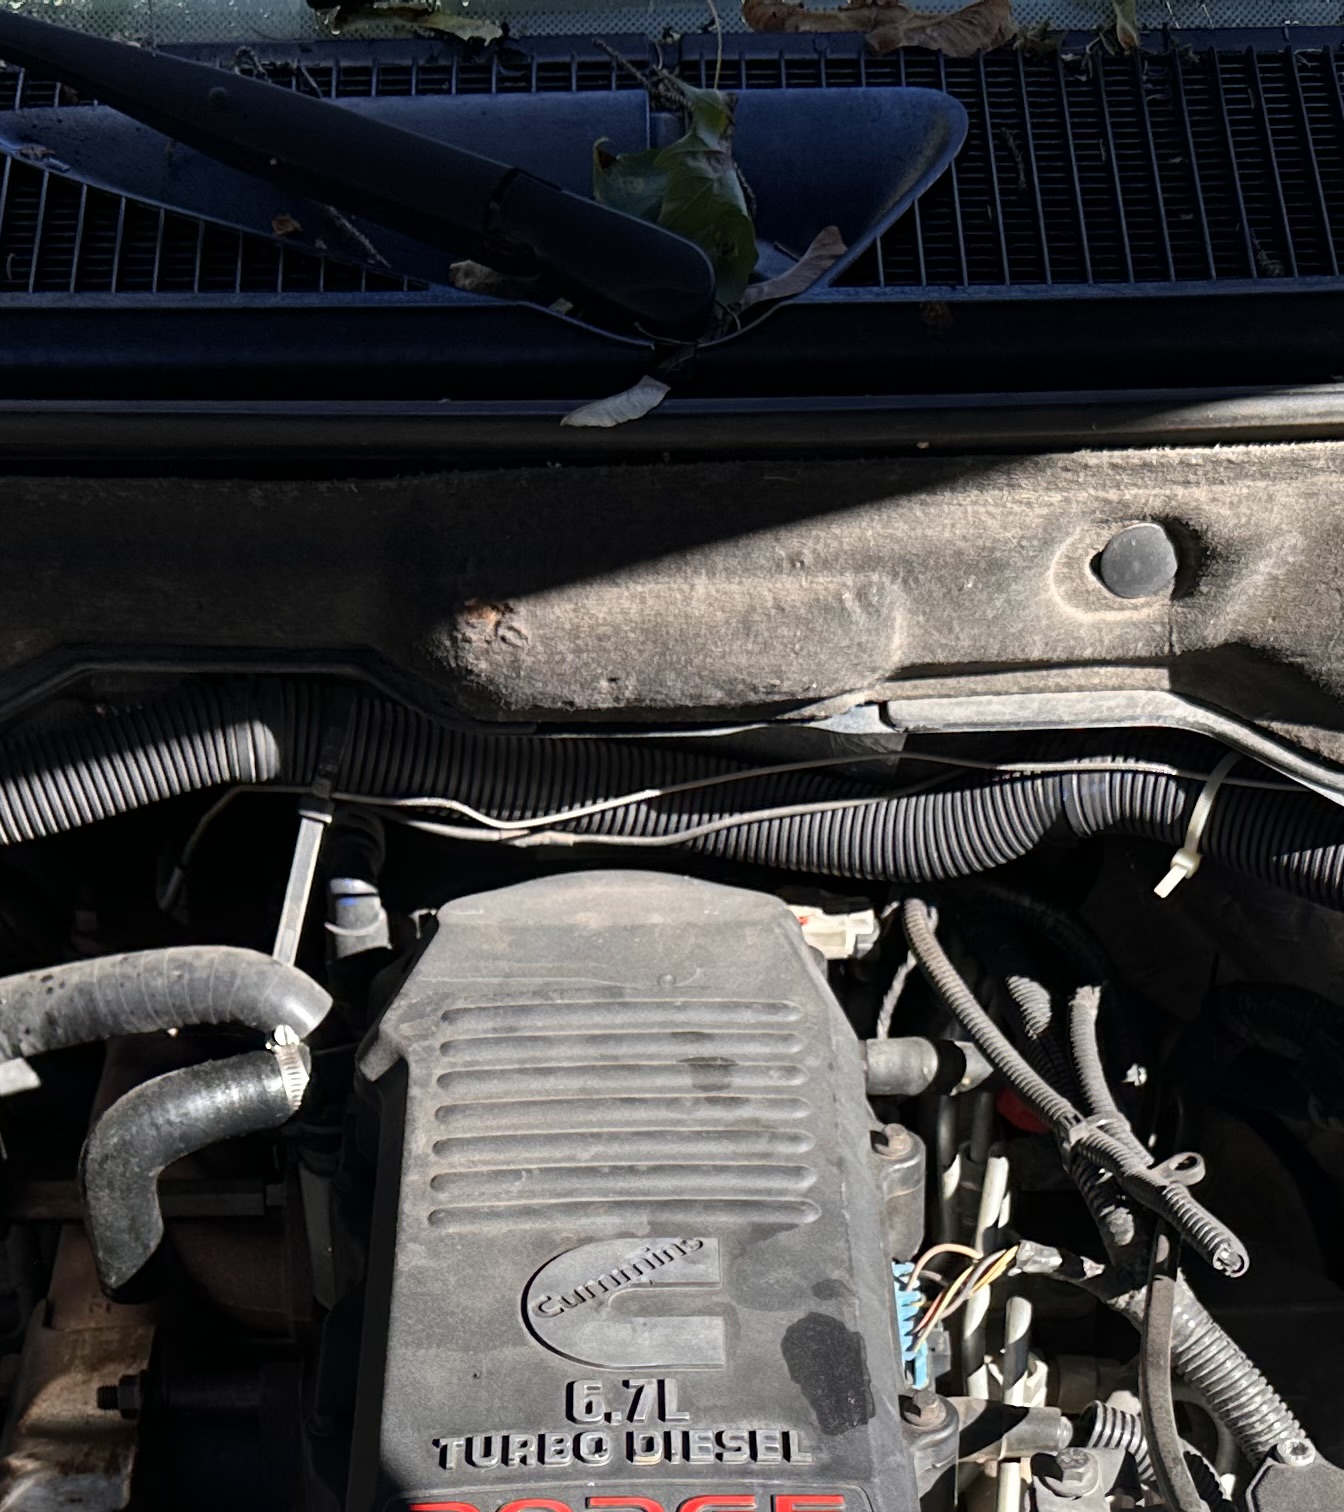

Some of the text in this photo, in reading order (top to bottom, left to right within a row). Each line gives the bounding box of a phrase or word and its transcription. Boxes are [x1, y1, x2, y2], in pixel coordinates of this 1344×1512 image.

[566, 1378, 690, 1425] 6.7L
[433, 1428, 816, 1471] TURBO DIESEL
